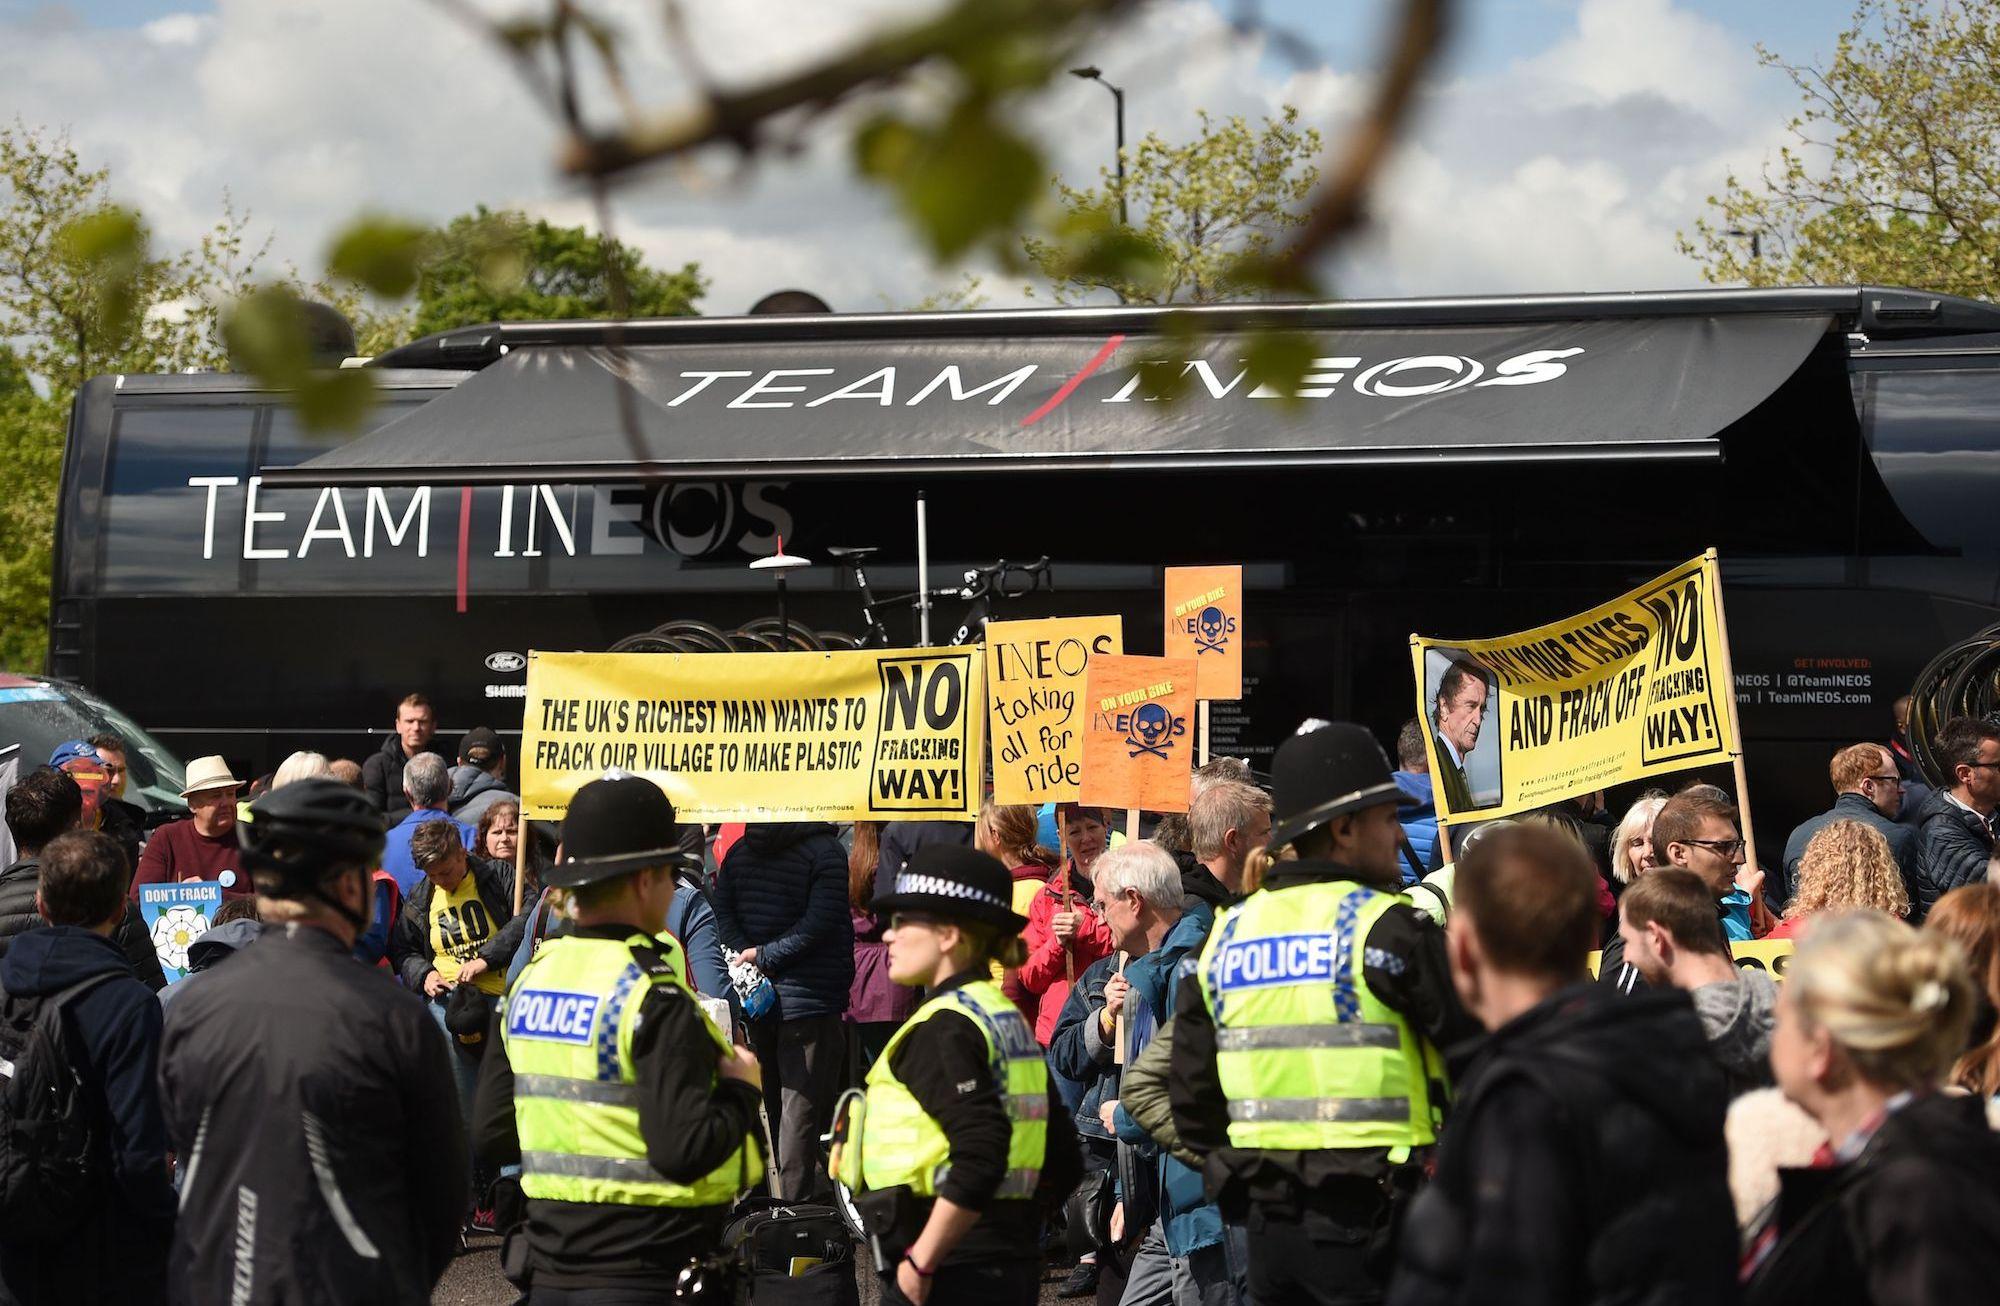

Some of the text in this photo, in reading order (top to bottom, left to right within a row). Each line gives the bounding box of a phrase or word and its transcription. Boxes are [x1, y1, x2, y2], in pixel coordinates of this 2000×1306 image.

[667, 365, 1039, 409] TEAM
[188, 476, 794, 559] TEAM INEOS
[1175, 586, 1226, 617] ON YOUR BIKE
[1648, 580, 1698, 672] NO
[1507, 638, 1583, 681] YOUR
[1561, 612, 1650, 671] TAXES
[1794, 658, 1872, 668] GET INVOLVED:
[884, 662, 962, 731] NO
[1101, 681, 1175, 712] ON YOUR BIKE
[1650, 667, 1704, 706] FRACKING
[1768, 691, 1872, 704] TeamINEOS.com
[1787, 674, 1872, 687] @TeamINEOS
[542, 697, 867, 733] THE UK'S RICHEST MAN WANTS TO
[993, 686, 1075, 725] taking
[1510, 664, 1646, 751] AND FRACK OFF
[1001, 725, 1073, 763] all for
[1647, 703, 1714, 750] WAY!
[536, 740, 862, 773] FRACK OUR VILLAGE TO MAKE PLASTIC
[879, 738, 960, 761] FRACKING
[878, 769, 959, 800] WAY!
[1024, 754, 1080, 792] ride
[815, 804, 855, 812] Farmhouse
[145, 887, 217, 903] DON'T FRACK
[437, 899, 490, 949] NO
[1223, 938, 1330, 984] POLICE
[511, 995, 595, 1036] POLICE
